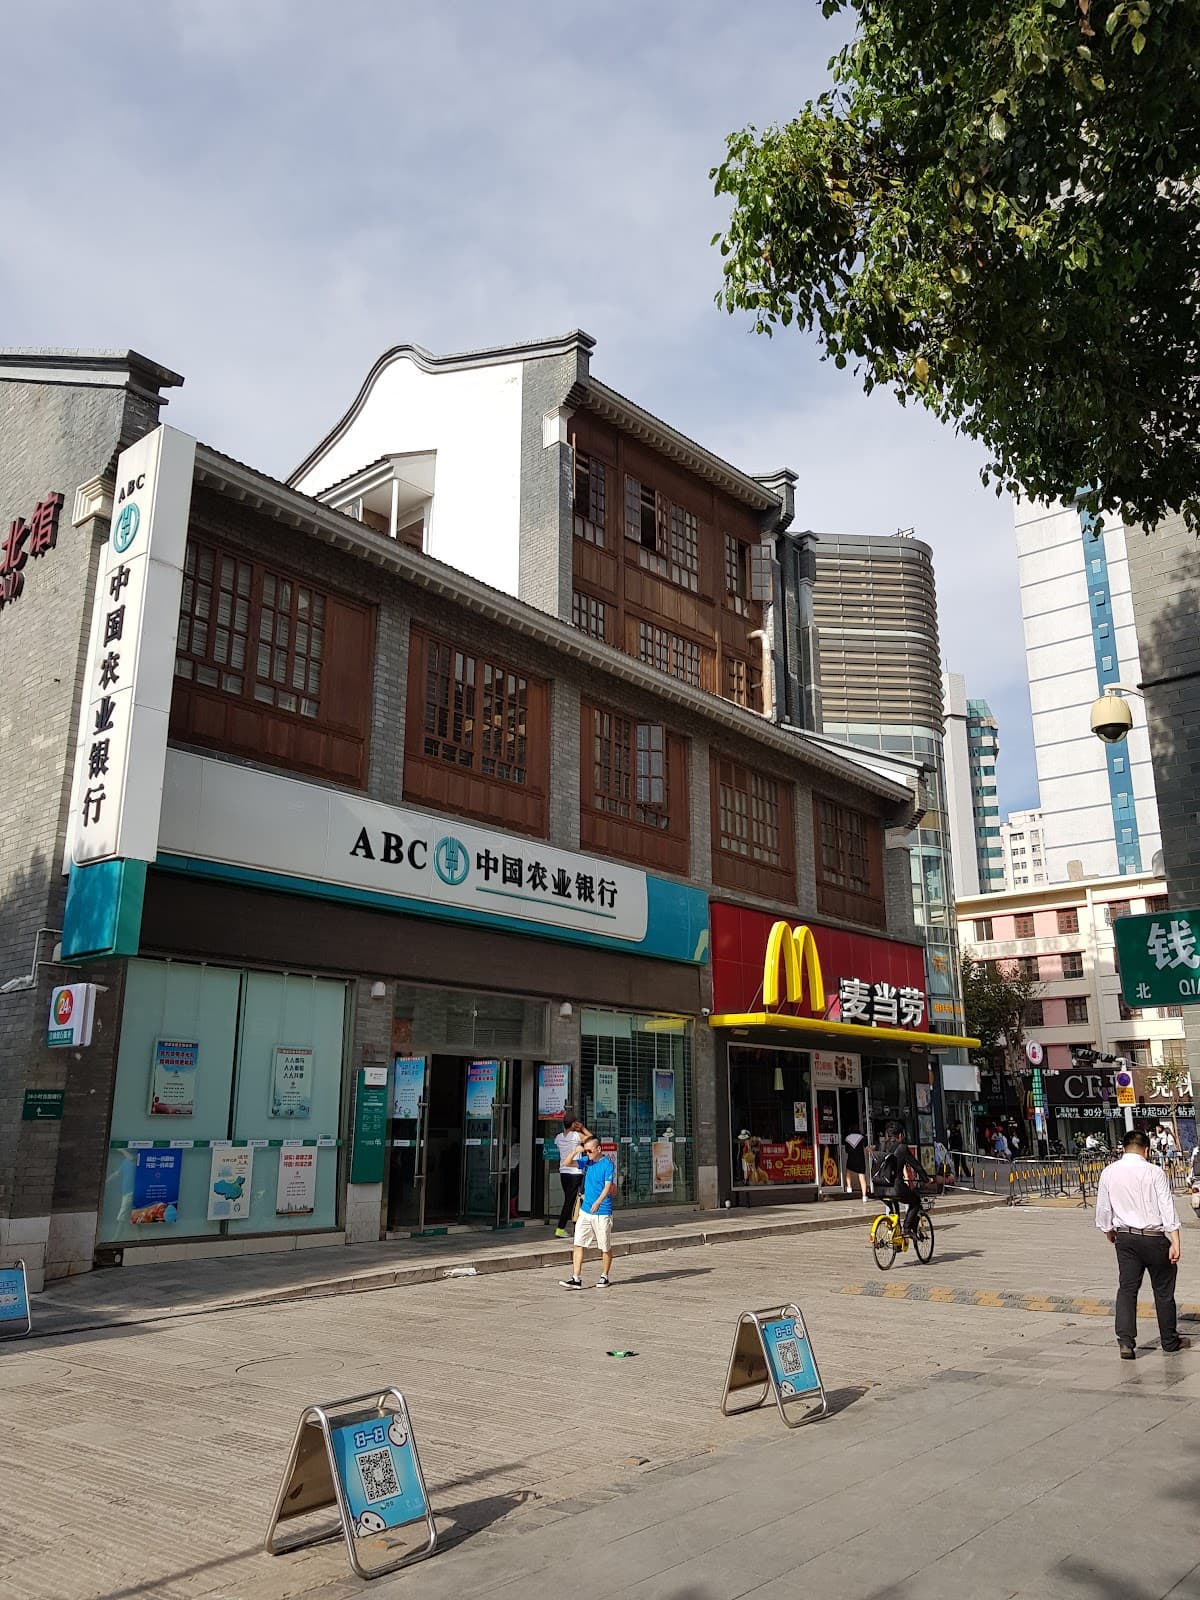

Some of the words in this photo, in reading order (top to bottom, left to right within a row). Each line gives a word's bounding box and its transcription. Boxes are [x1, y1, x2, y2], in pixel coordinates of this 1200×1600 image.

[118, 473, 146, 504] ABC
[82, 565, 129, 828] 中国农业银行
[350, 826, 428, 870] ABC
[476, 849, 617, 909] 中国农业银行
[1147, 920, 1200, 970] 钱
[840, 977, 925, 1028] 麦当劳
[1136, 983, 1152, 999] 北
